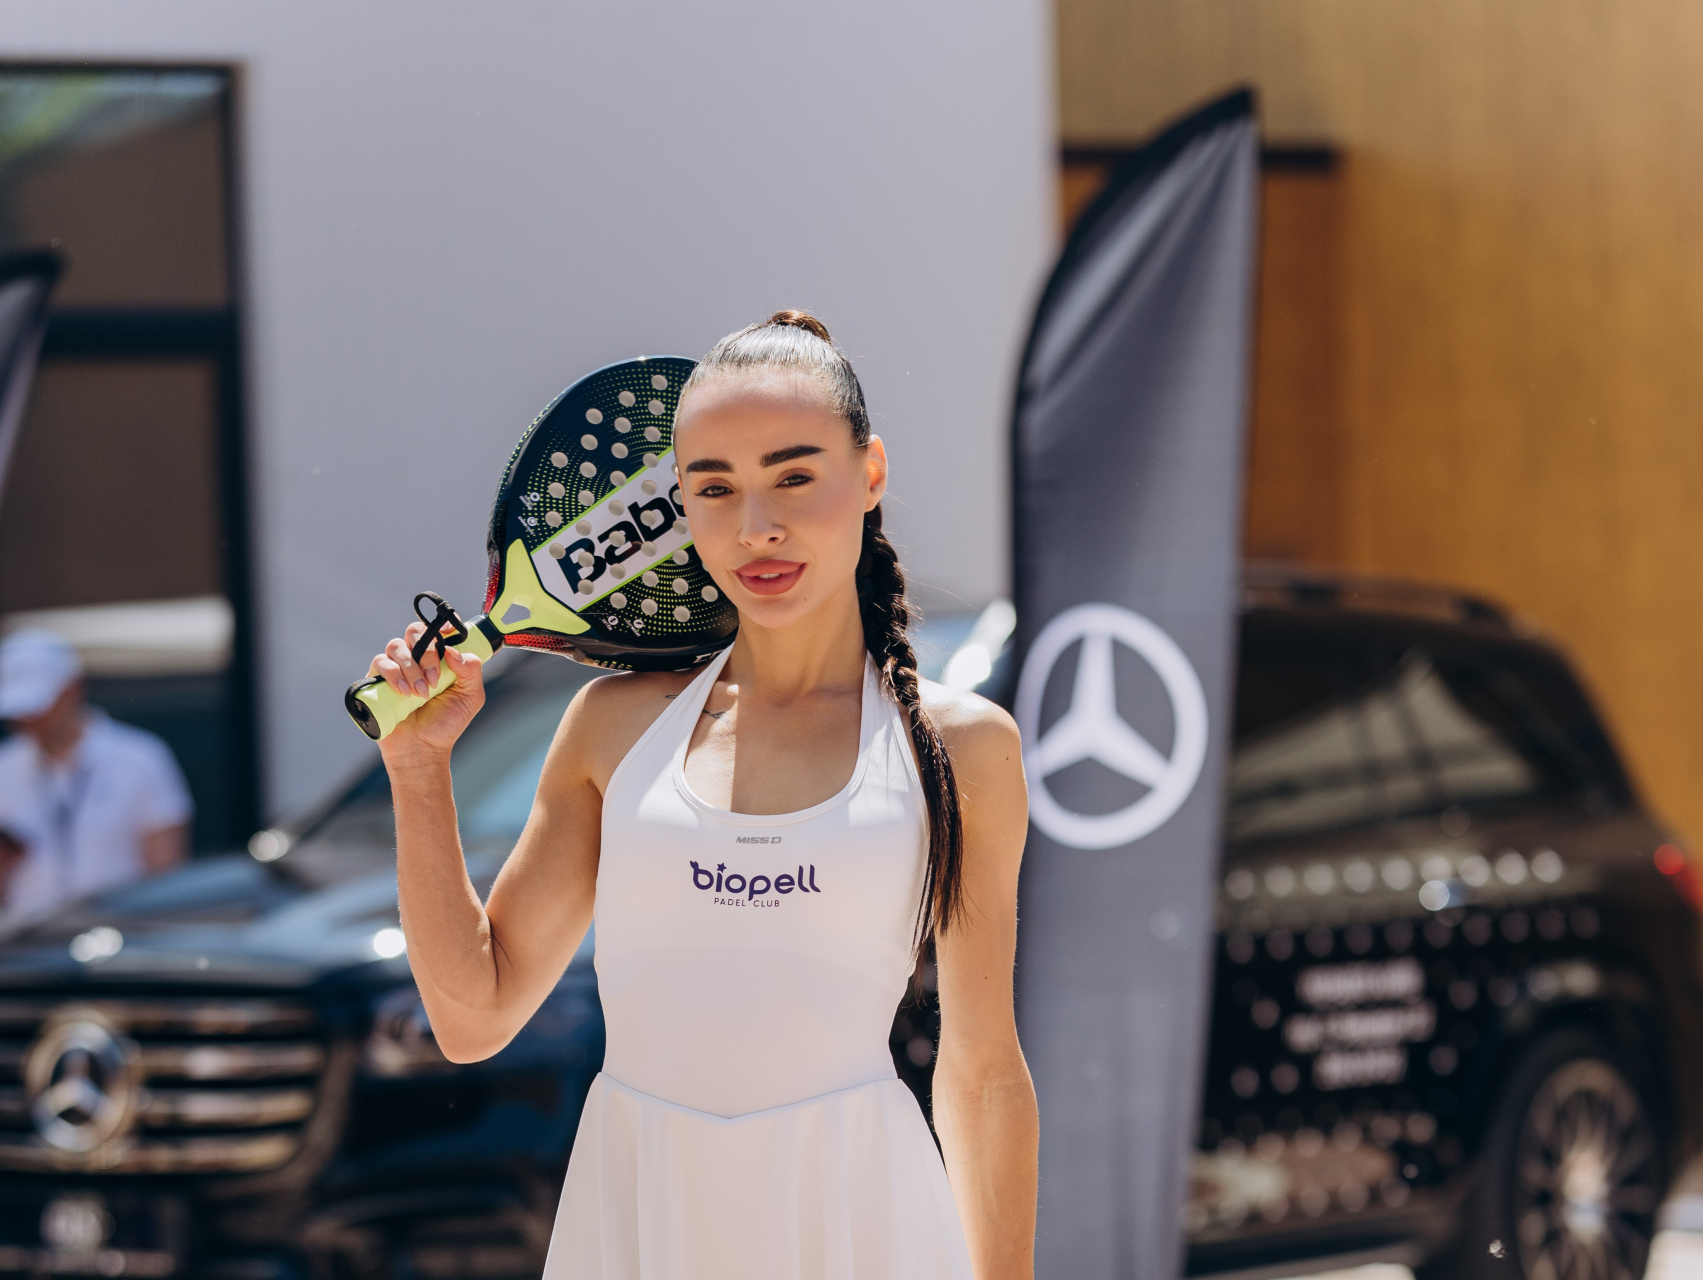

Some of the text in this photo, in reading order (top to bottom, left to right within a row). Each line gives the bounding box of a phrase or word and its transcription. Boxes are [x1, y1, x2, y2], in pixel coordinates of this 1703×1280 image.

[736, 836, 770, 844] MISS
[690, 860, 822, 902] biopell
[714, 897, 780, 908] PADEL CLUB
